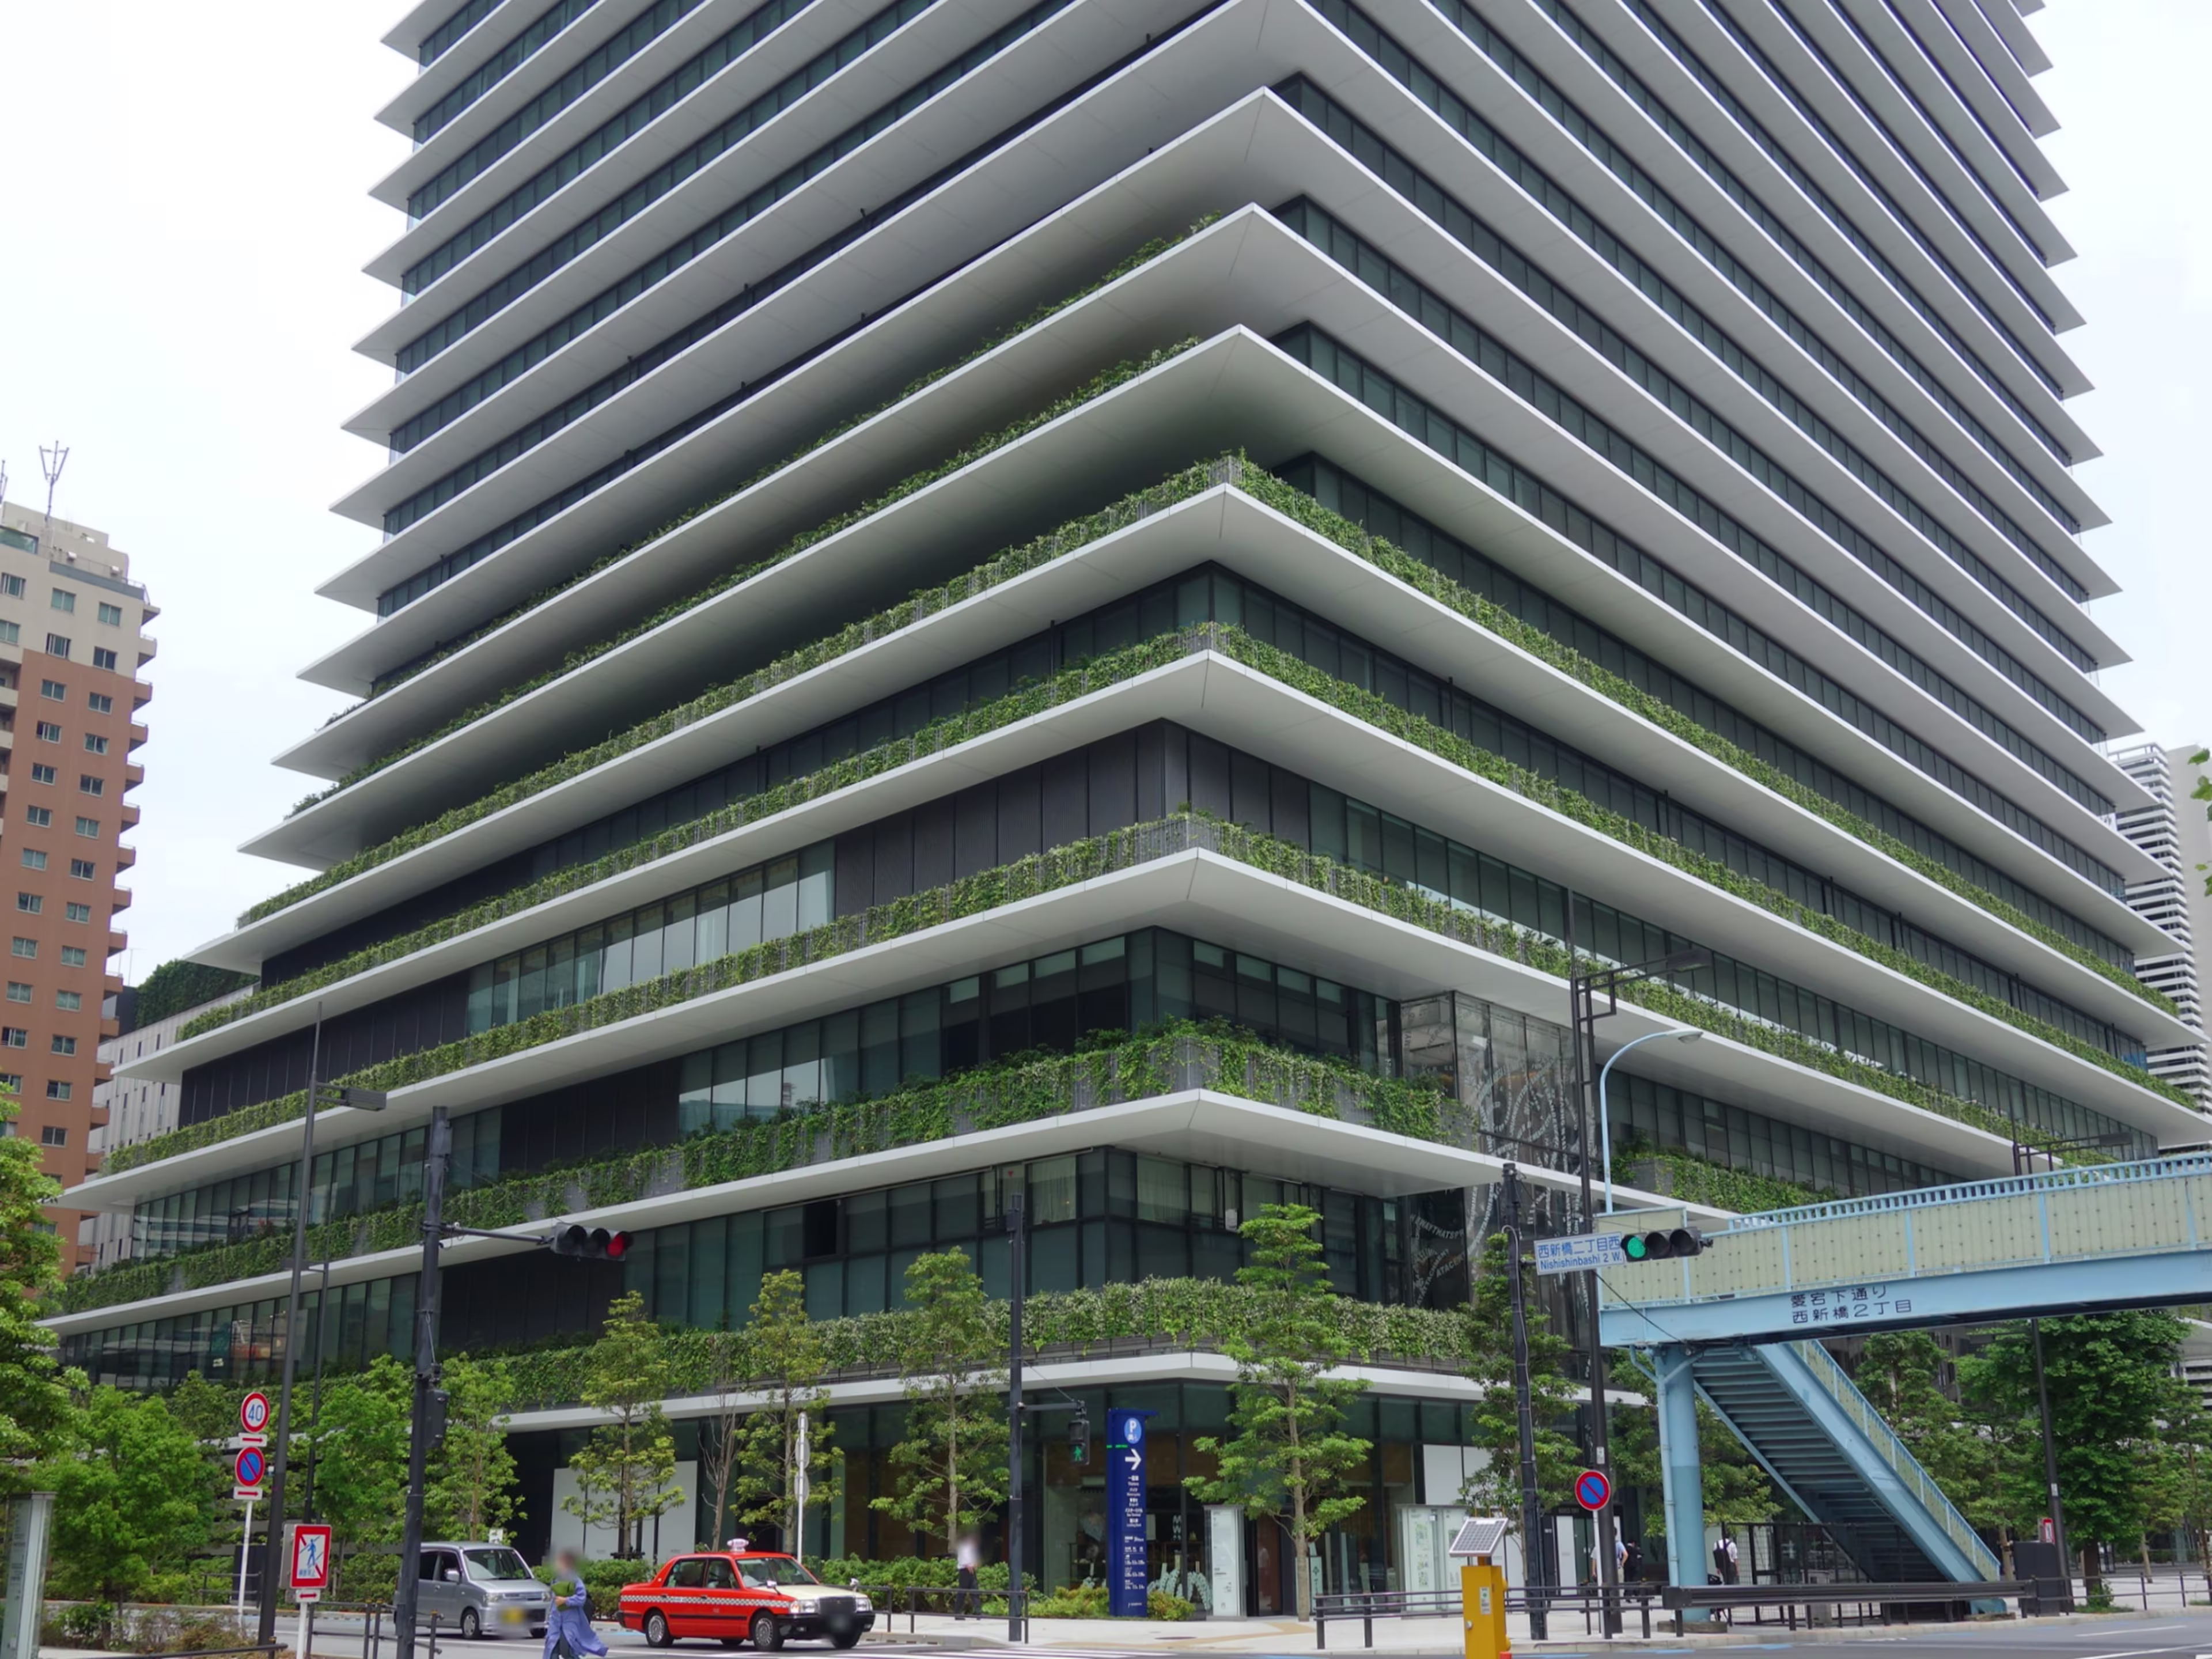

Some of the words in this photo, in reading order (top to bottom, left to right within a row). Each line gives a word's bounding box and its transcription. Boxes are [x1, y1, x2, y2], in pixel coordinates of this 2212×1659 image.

[1537, 1235, 1620, 1259] 西新橋二丁目西
[1540, 1255, 1600, 1270] Nishishinbashi
[1603, 1253, 1609, 1263] 2
[1612, 1252, 1622, 1262] W.
[248, 1404, 263, 1422] 40
[1129, 1420, 1137, 1433] P
